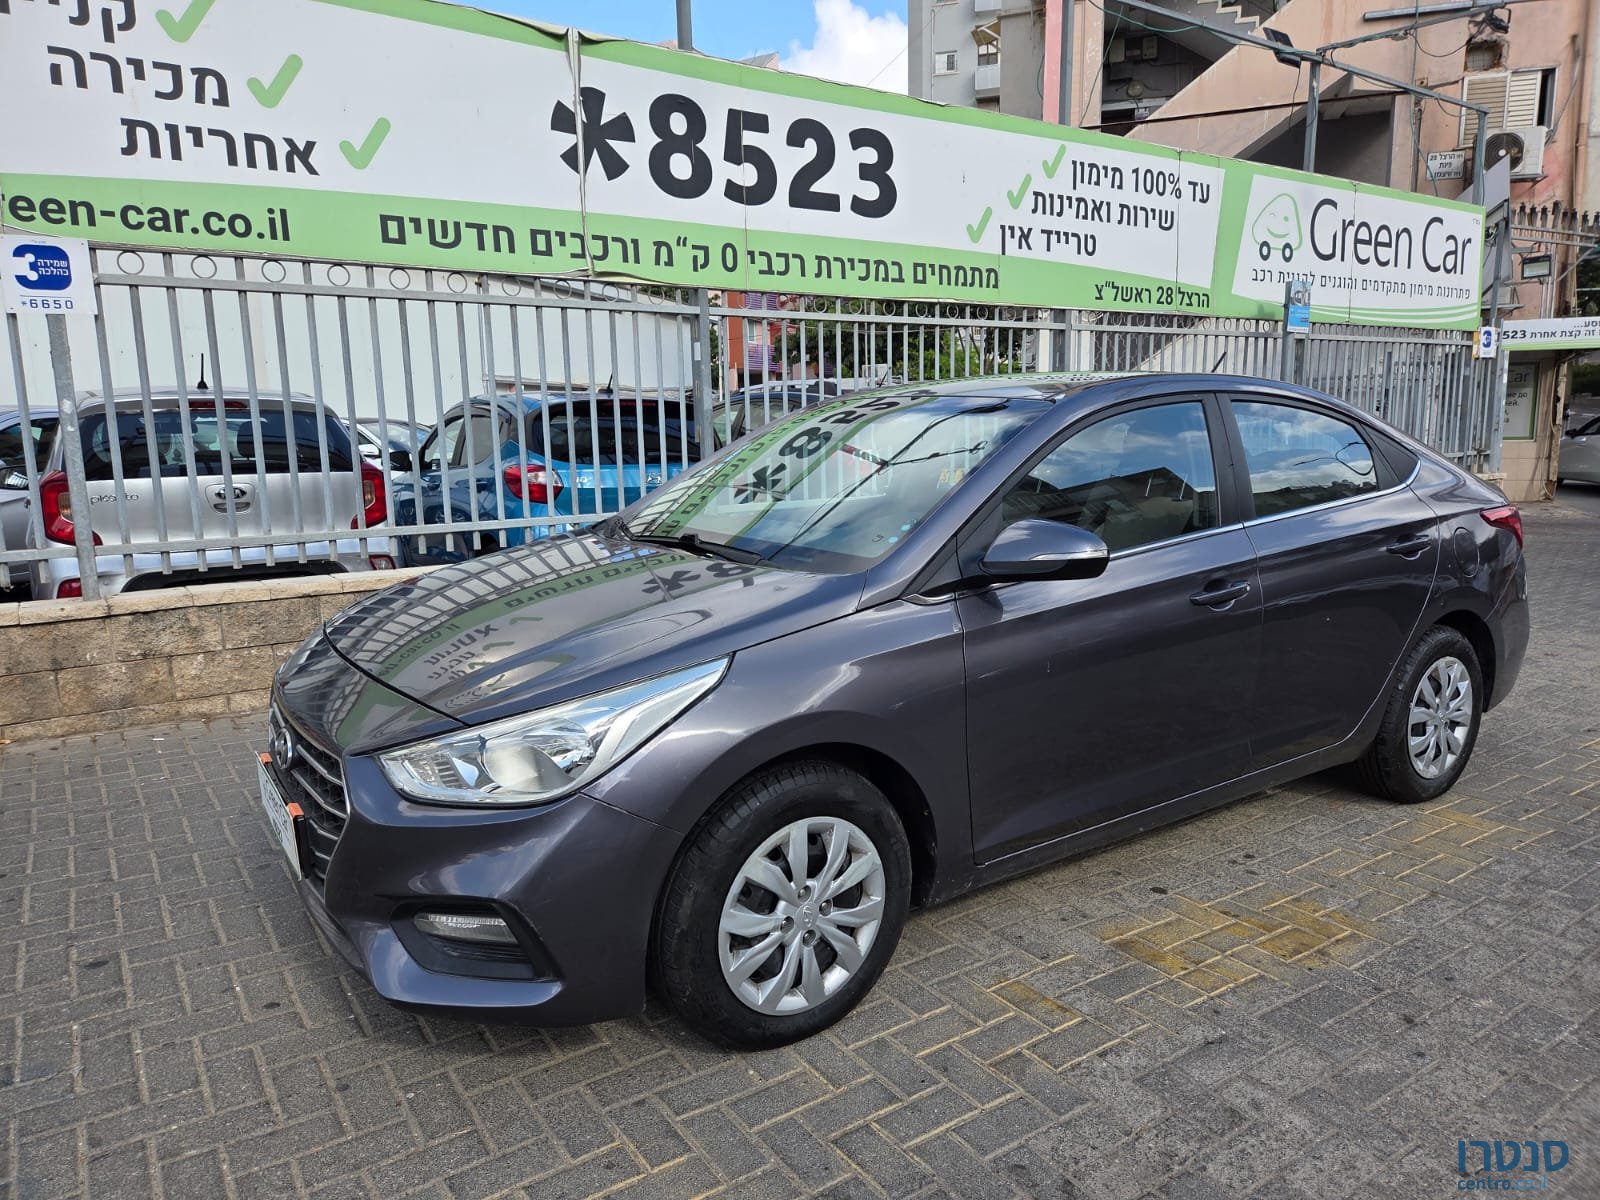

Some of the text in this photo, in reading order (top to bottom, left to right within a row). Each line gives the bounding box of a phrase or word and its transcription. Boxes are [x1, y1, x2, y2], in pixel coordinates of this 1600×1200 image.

[47, 45, 231, 108] מכירה
[120, 117, 320, 176] אחריות
[1072, 160, 1211, 204] עד 100% מימון
[1, 193, 291, 242] een-car.co.il
[1031, 191, 1175, 231] שירות ואמינות
[379, 214, 516, 255] חדשים
[529, 228, 641, 265] ורכבים
[1000, 224, 1097, 256] טרייד אין
[1310, 198, 1472, 276] Green Car
[37, 259, 68, 268] שמירה
[721, 242, 738, 272] 0
[747, 250, 806, 277] רכבי
[815, 255, 905, 284] במכירת
[913, 262, 999, 289] מתמחים
[1252, 268, 1273, 282] רכב
[1321, 275, 1357, 290] והוגנים
[1361, 279, 1406, 296] מתקדמים
[1095, 280, 1210, 308] הרצל 28 ראשל"צ
[1409, 283, 1434, 298] מימון
[1437, 285, 1471, 299] פתרונות
[1530, 331, 1558, 339] אחרת
[90, 493, 139, 506] picato
